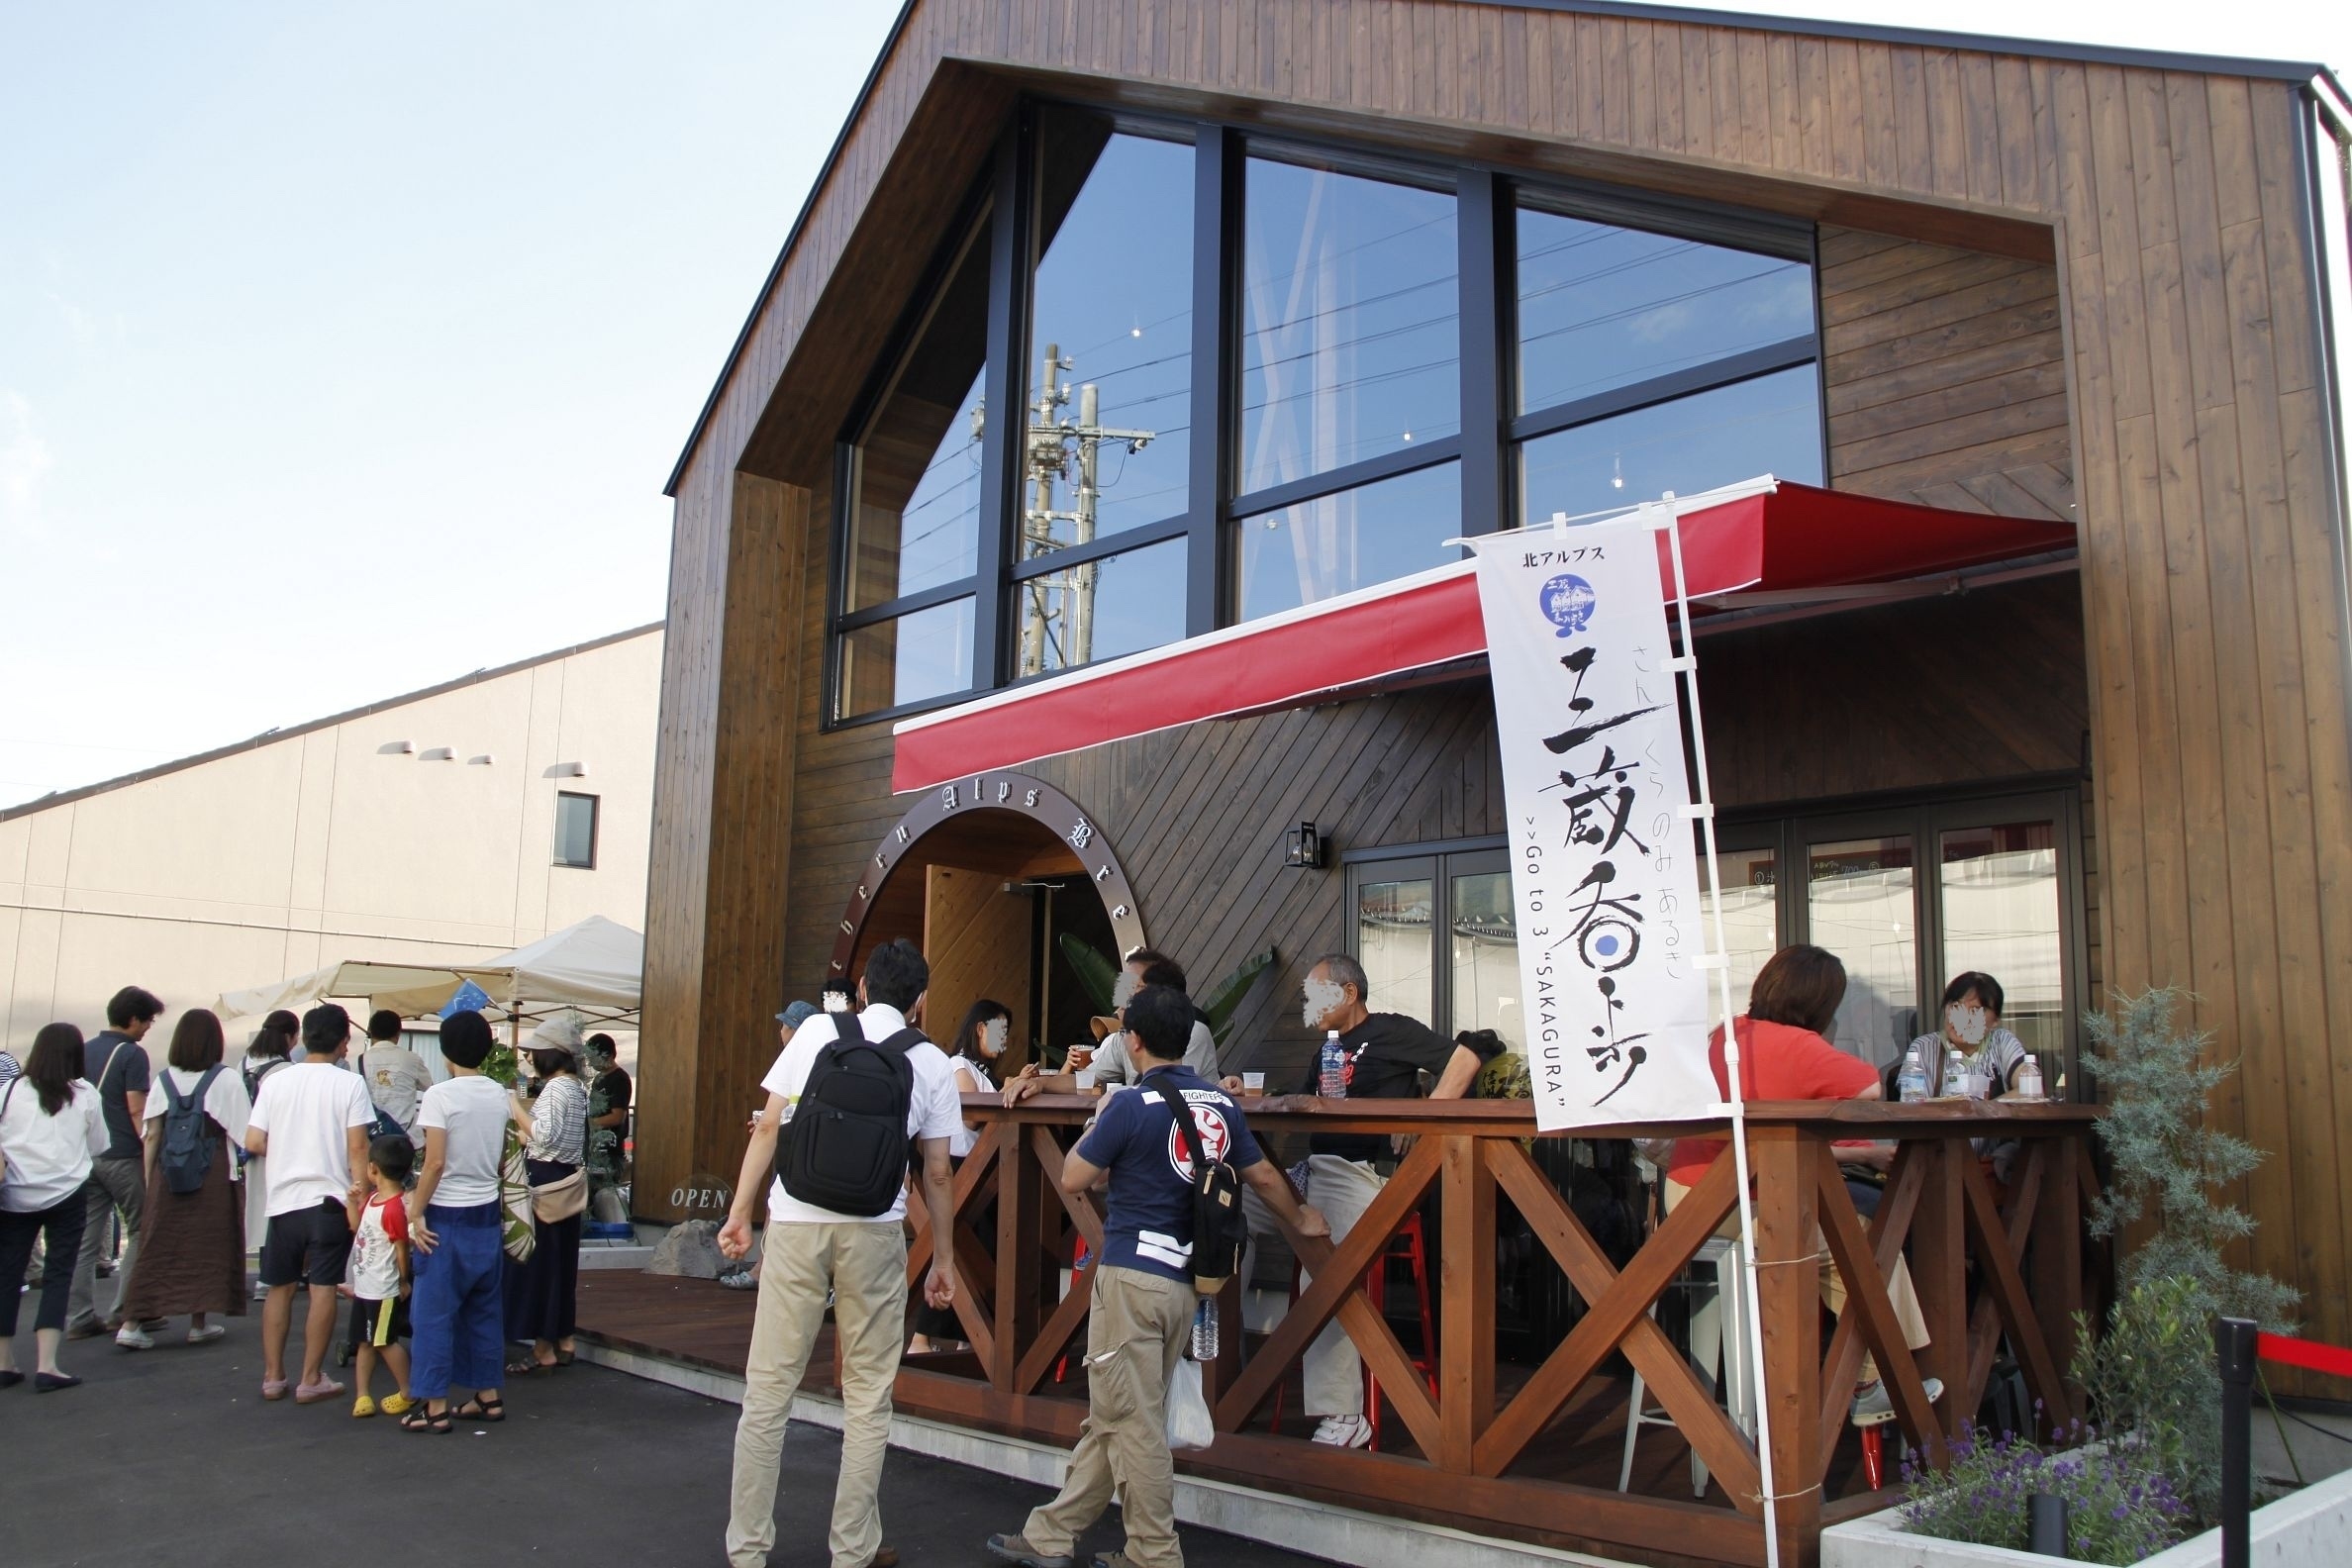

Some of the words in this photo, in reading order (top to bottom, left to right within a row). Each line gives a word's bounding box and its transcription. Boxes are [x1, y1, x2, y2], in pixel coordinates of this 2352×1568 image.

[1522, 545, 1605, 568] 北アルプス
[832, 825, 911, 971] thern
[942, 776, 1041, 812] Alps
[1529, 889, 1544, 912] to
[1532, 927, 1549, 936] 3
[671, 1188, 728, 1209] OPEN
